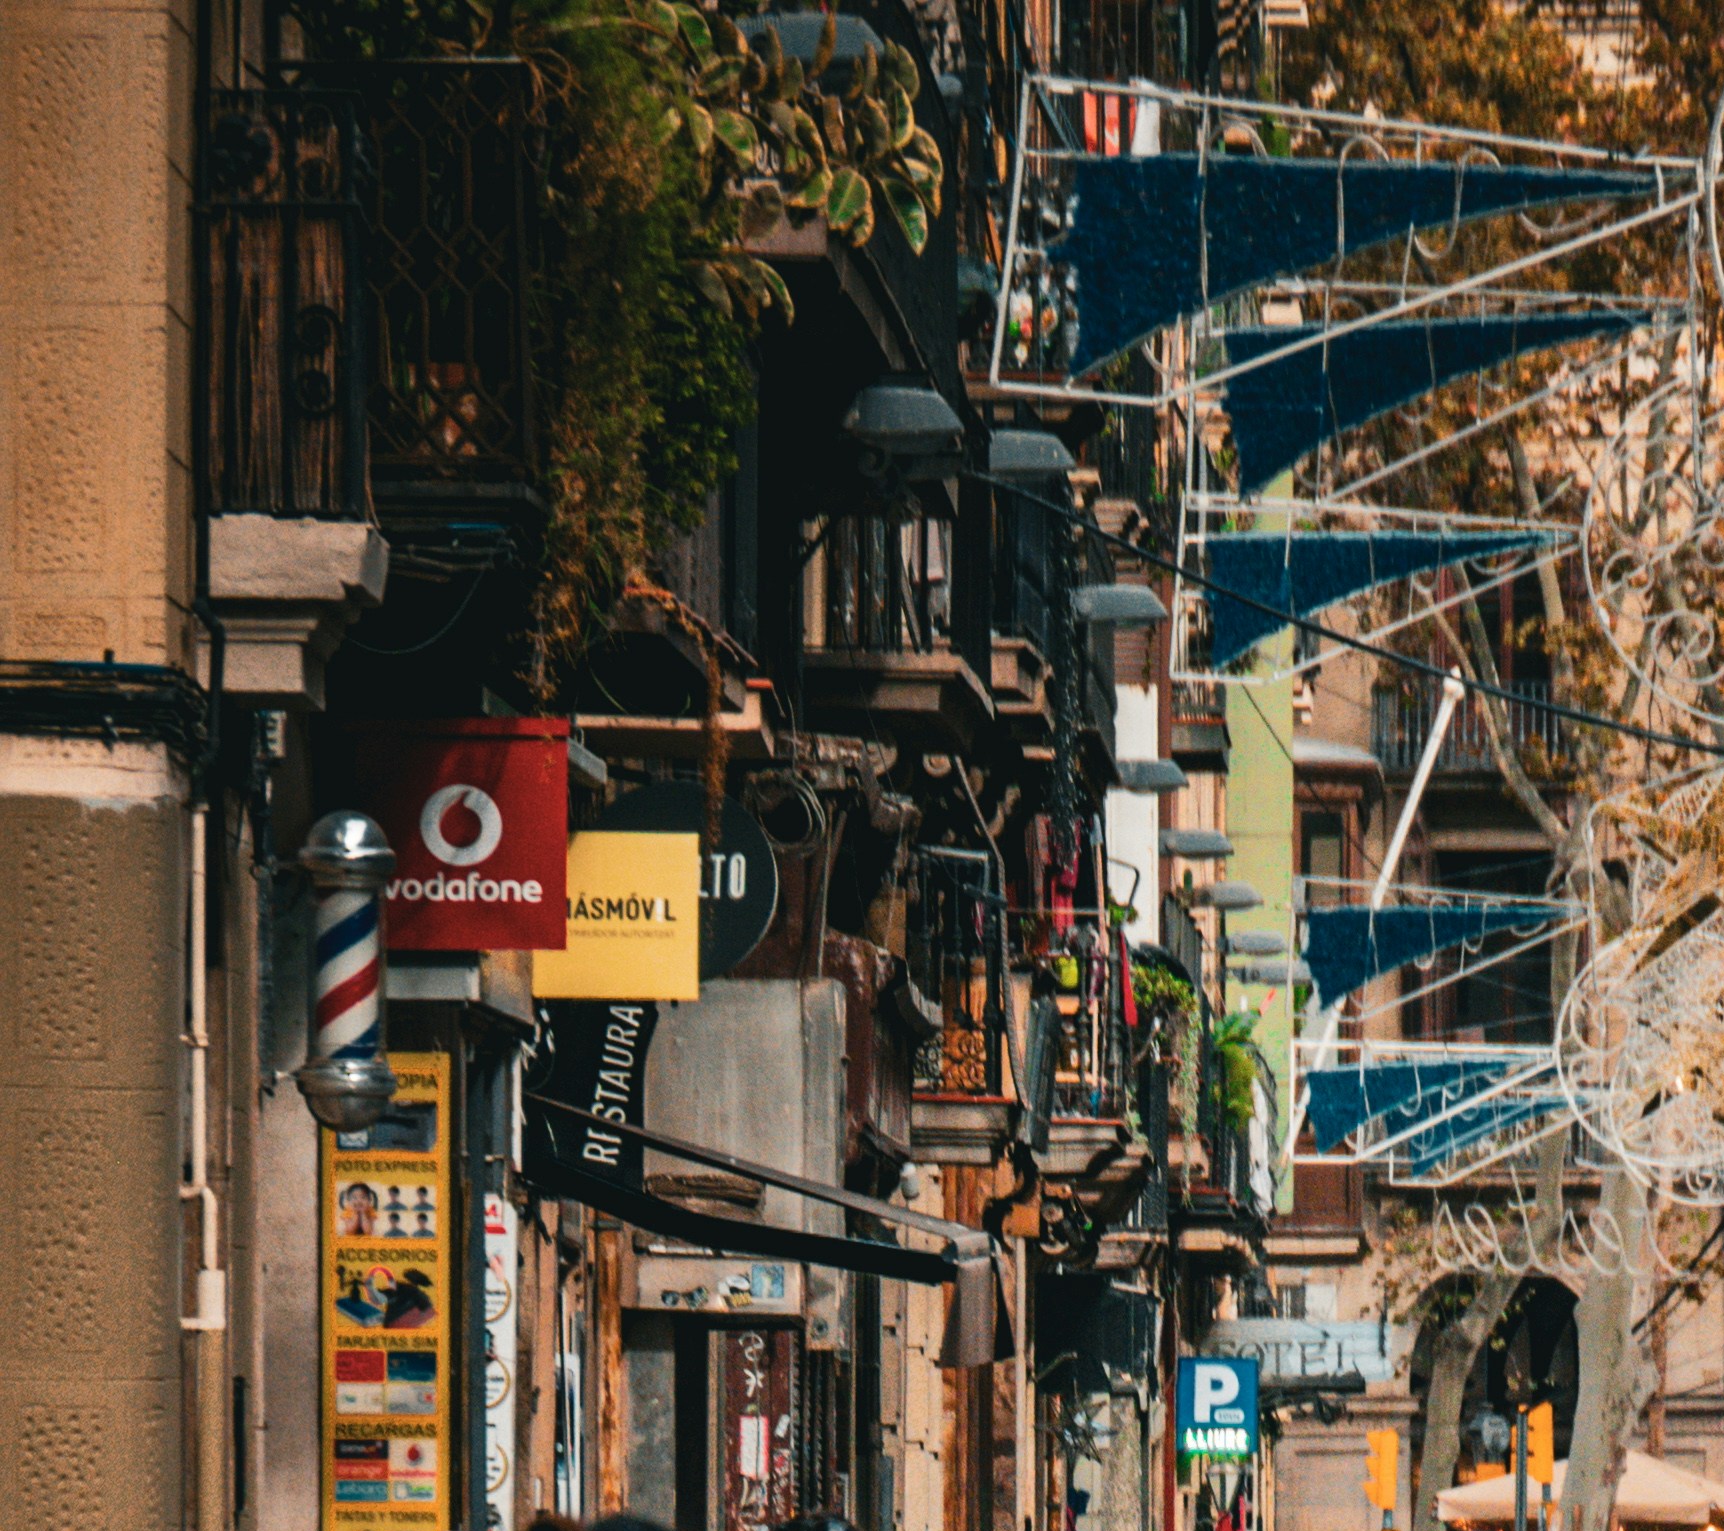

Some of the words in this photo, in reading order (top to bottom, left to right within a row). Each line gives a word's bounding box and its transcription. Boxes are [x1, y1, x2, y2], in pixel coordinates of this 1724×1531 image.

[385, 871, 543, 903] vodafone
[335, 1160, 372, 1173] FOTO
[376, 1160, 438, 1173] EXPRESS
[336, 1248, 438, 1263] ACCESORIOS
[412, 1336, 438, 1349] SIM
[335, 1422, 437, 1438] RECARGAS
